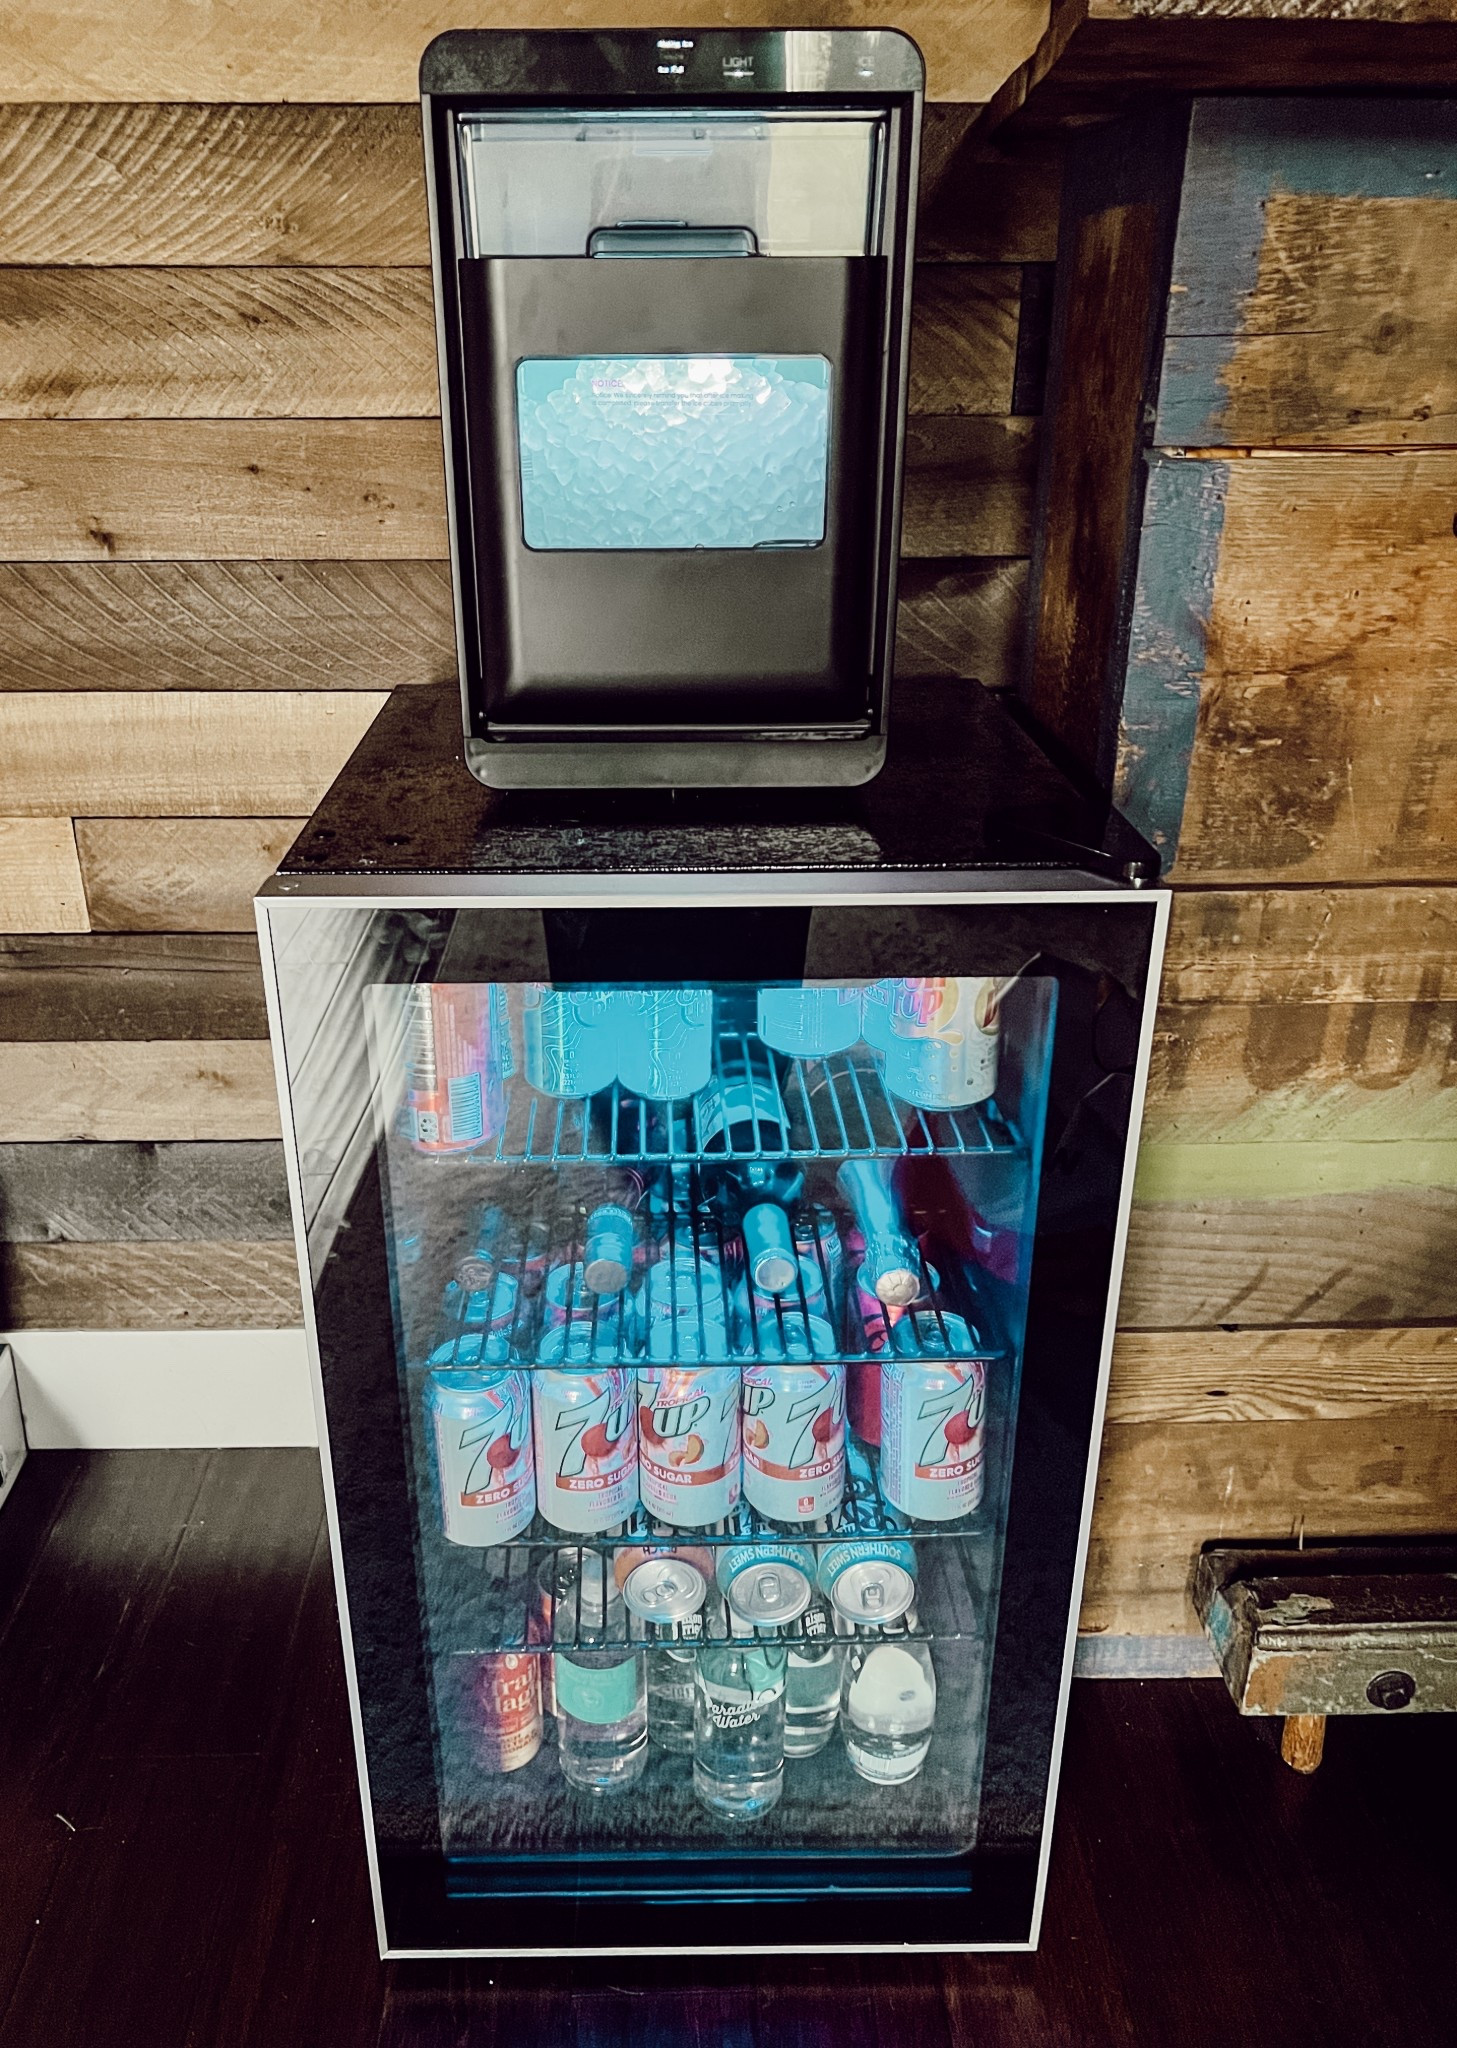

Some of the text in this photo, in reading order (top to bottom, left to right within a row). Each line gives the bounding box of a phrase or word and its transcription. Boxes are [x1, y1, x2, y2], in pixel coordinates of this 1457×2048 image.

[722, 56, 753, 68] LIGHT
[858, 55, 875, 67] ICE
[592, 379, 624, 388] NOTICE
[743, 1376, 773, 1386] OPICAL
[657, 1386, 707, 1407] TROPICAL
[653, 1465, 693, 1484] SUGAR
[799, 1462, 831, 1479] ZERO
[929, 1465, 964, 1479] ZERO
[475, 1478, 511, 1505] ZERO
[569, 1478, 605, 1490] ZERO
[729, 1545, 805, 1573] SOUTHERN SWEET
[827, 1542, 901, 1577] SOUTHERN SWEET
[713, 1713, 760, 1728] Water
